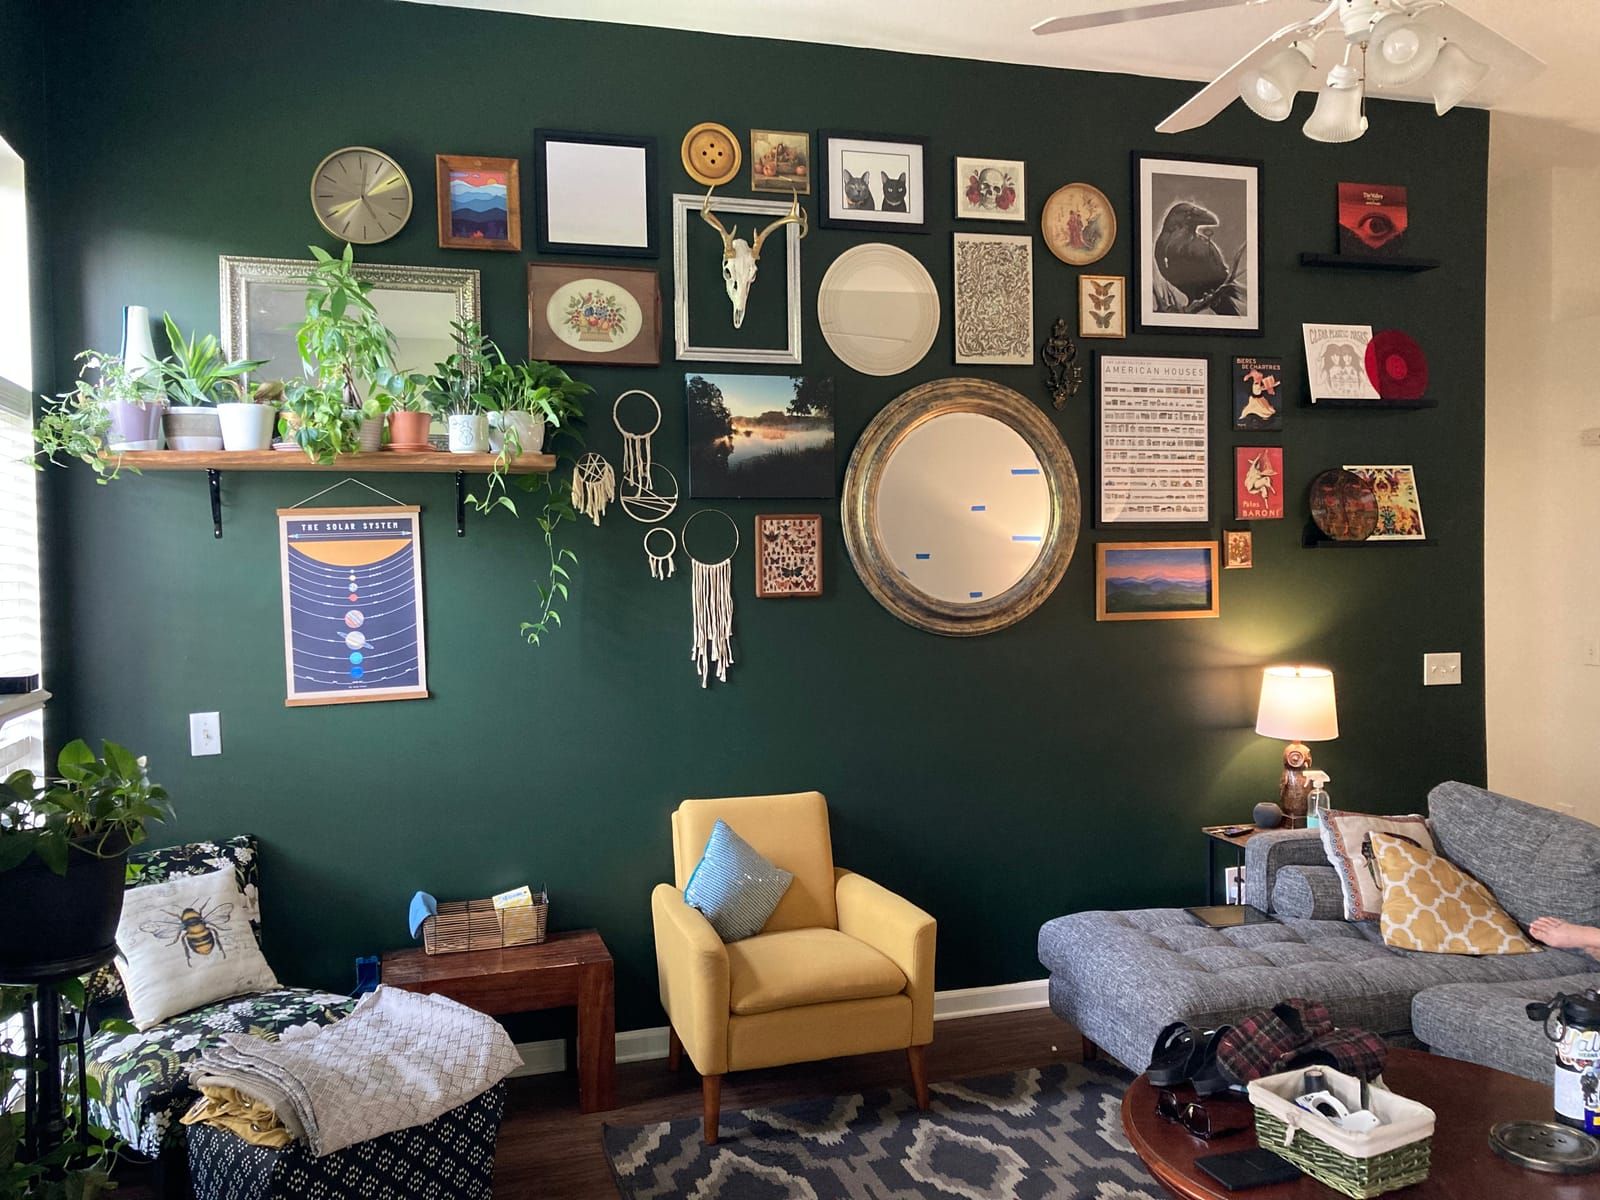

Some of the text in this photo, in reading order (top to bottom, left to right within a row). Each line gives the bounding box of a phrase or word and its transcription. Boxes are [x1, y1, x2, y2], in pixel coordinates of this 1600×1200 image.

[1105, 366, 1204, 376] AMERICAN HOUSES
[301, 521, 399, 531] THE SOLAR SYSTEM
